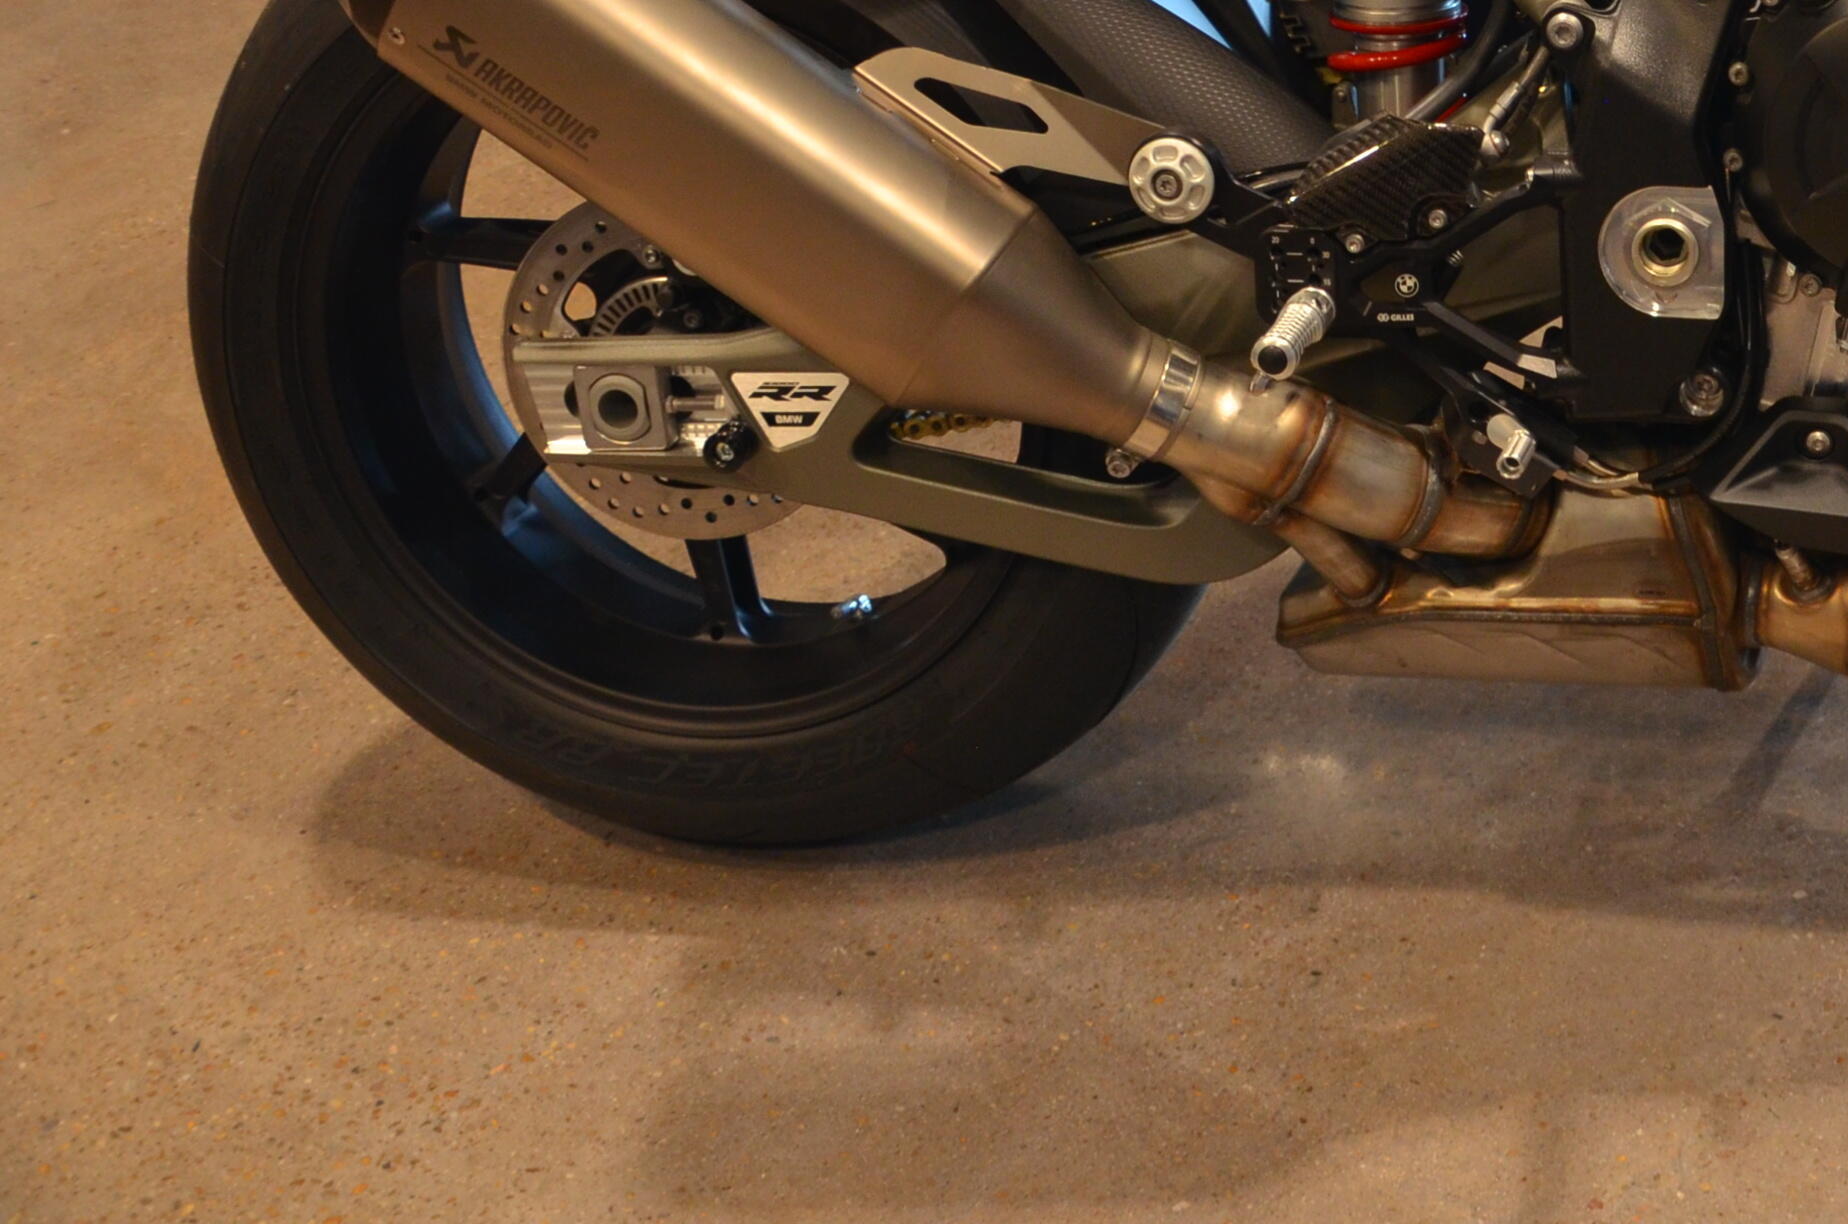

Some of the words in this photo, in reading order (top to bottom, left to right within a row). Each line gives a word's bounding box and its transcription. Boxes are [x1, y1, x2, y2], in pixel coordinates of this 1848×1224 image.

[1391, 313, 1415, 322] GILLES
[748, 385, 837, 402] RR
[775, 414, 804, 425] BMW
